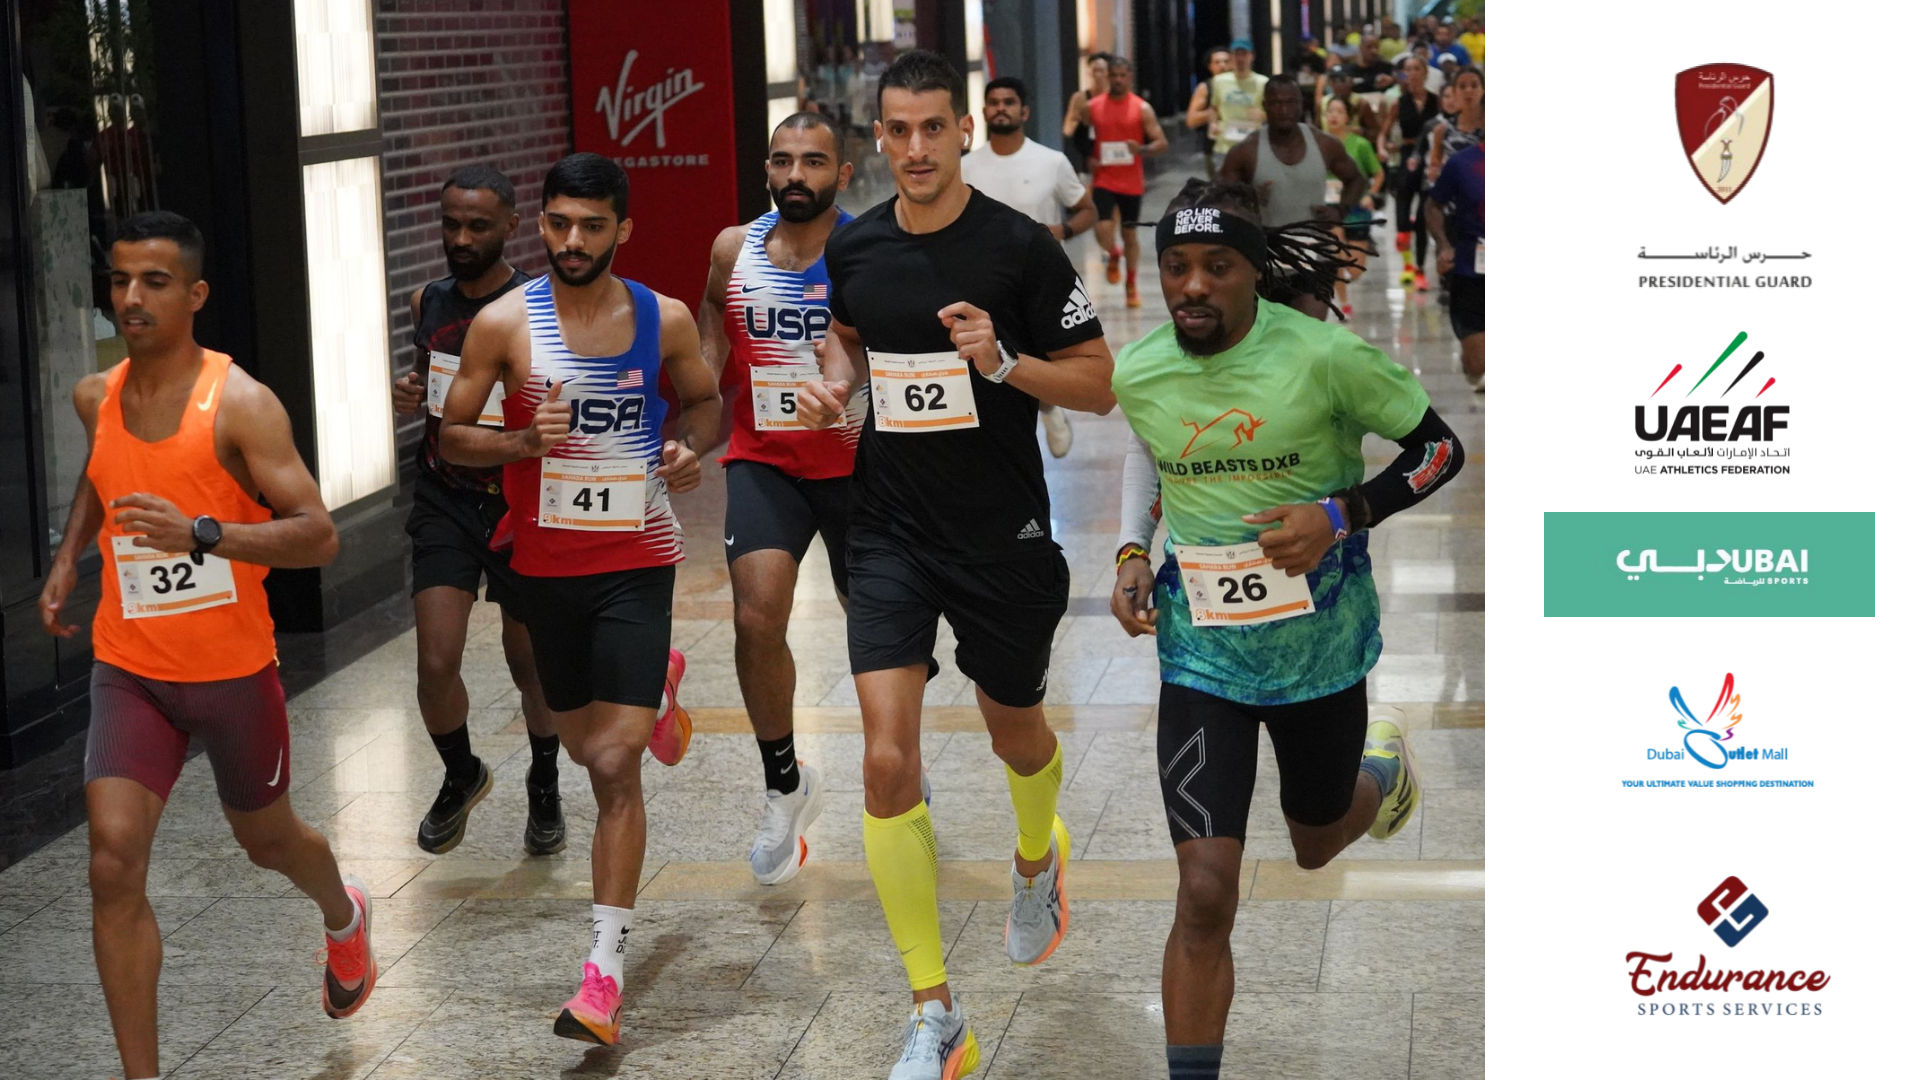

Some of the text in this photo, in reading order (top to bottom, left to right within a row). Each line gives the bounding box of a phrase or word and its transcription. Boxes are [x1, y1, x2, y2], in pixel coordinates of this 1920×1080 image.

[595, 50, 705, 149] Virgin
[1175, 215, 1213, 226] NEVER
[1176, 207, 1221, 218] GO LIKE
[1174, 223, 1224, 235] BEFORE.
[746, 306, 832, 341] USA
[904, 383, 947, 412] 62
[1157, 452, 1301, 476] WILD BEASTS DXB
[572, 487, 610, 512] 41
[150, 562, 196, 594] 32
[1217, 573, 1267, 603] 26
[1195, 608, 1229, 621] 8km
